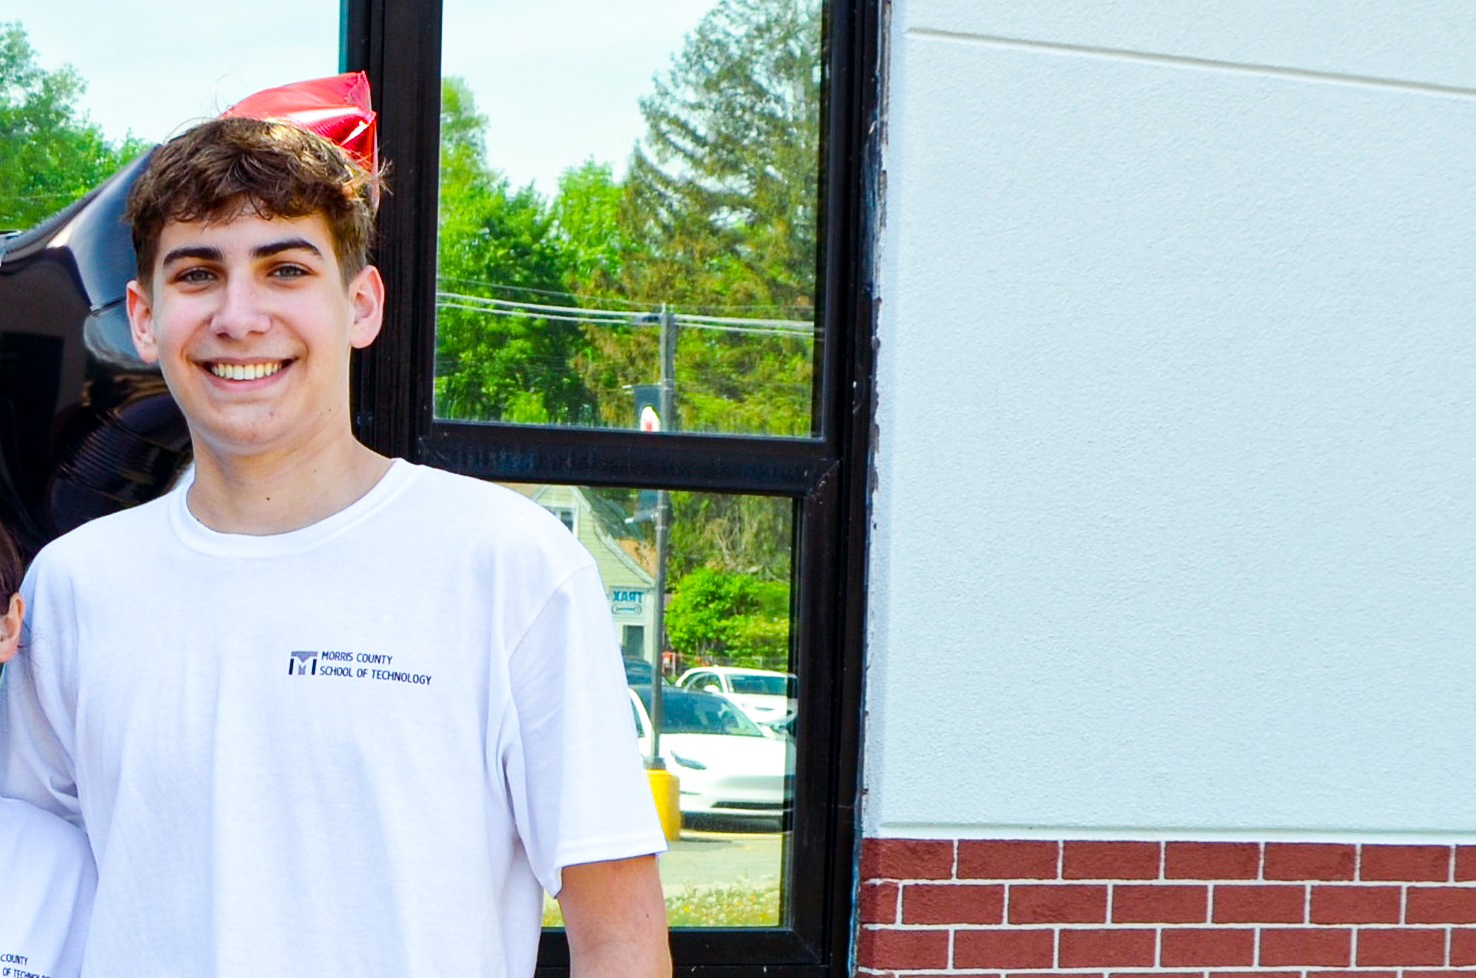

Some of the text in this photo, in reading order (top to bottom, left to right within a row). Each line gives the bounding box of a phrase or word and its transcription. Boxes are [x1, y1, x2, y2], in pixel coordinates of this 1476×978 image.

[321, 651, 393, 665] MORRIS COUNTY
[319, 665, 432, 686] SCHOOL OF TECHNOLOGY
[0, 953, 29, 966] COUNTY
[2, 967, 12, 977] OF
